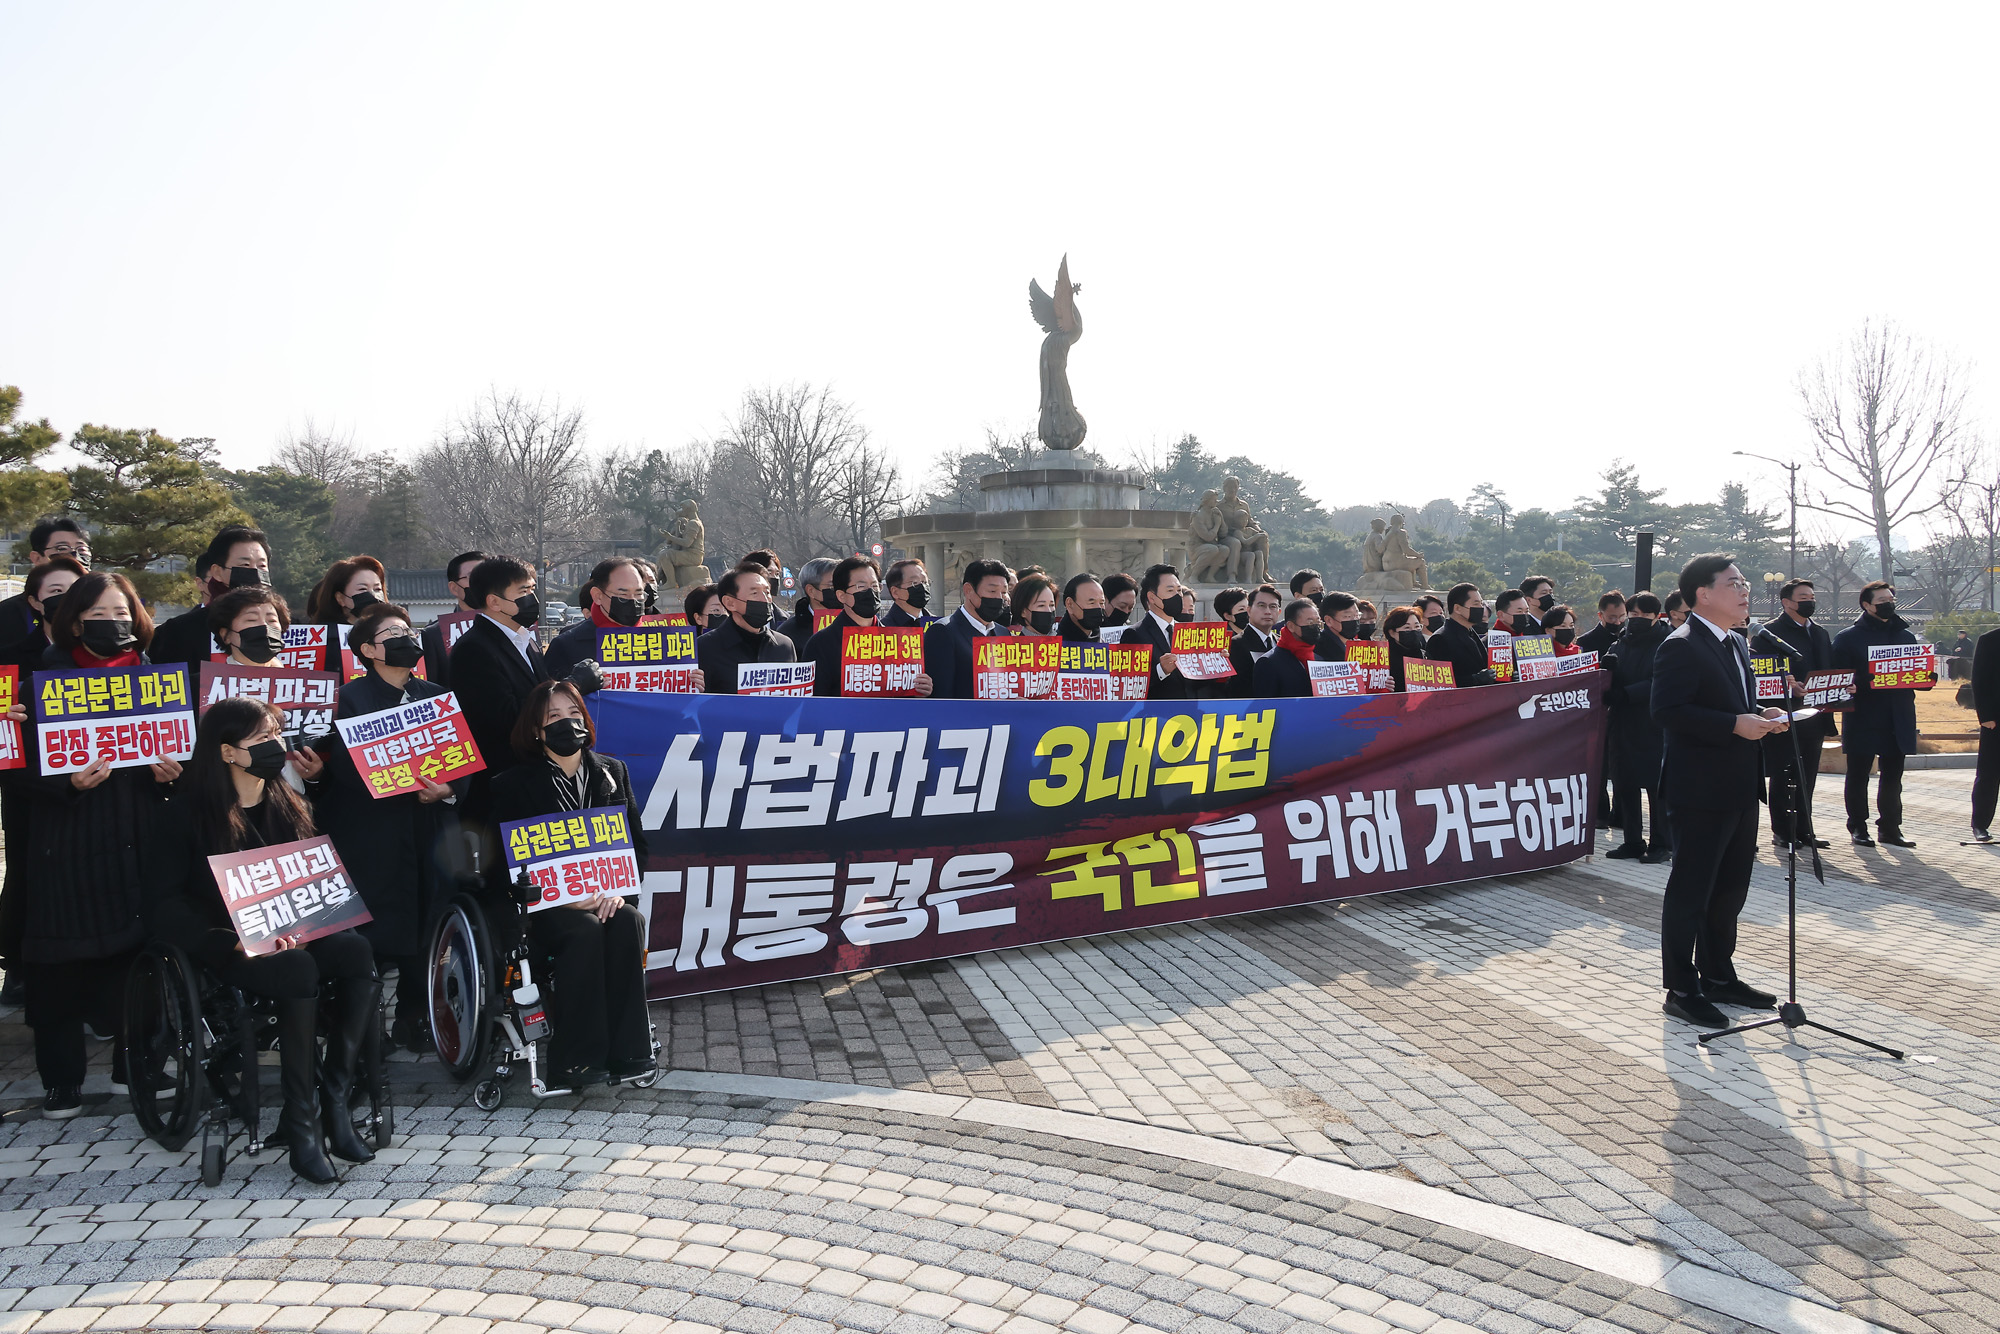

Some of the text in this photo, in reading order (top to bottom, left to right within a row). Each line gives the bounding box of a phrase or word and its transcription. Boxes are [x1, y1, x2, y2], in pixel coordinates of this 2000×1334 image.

[601, 632, 695, 662] 삼권분립 파괴
[845, 633, 922, 659] 사법파괴 3법
[1174, 627, 1208, 650] 사법파괴
[1209, 627, 1225, 649] 3법
[276, 650, 317, 670] 민국
[977, 642, 1060, 668] 사법파괴 3법
[1060, 646, 1107, 670] 분립 파괴
[1109, 650, 1150, 673] 파괴 3법
[1347, 646, 1390, 666] 사법파괴 3법
[1750, 657, 1773, 674] 권분립
[1870, 646, 1920, 660] 사법파괴 악법
[1875, 658, 1927, 674] 대한민국
[741, 665, 811, 687] 사법파괴 악법
[844, 664, 882, 693] 대통령은
[977, 671, 1019, 699] 대통령은
[1316, 678, 1359, 695] 대한민국
[1406, 662, 1453, 684] 사법파괴 3법
[41, 670, 187, 716] 삼권분립 파괴
[207, 677, 338, 705] 사법 파괴
[1061, 677, 1108, 700] 중단하라!
[1540, 689, 1591, 713] 국민의힘
[345, 701, 437, 745] 사법파괴 악법
[45, 719, 191, 769] 당장 중단하라!
[362, 720, 459, 768] 대한민국
[368, 740, 477, 794] 헌정 수호!
[642, 709, 1276, 831] 사법파괴 3대악법
[509, 812, 629, 861] 삼권분립 파괴
[225, 843, 341, 905] 사법 파괴
[562, 856, 636, 896] 중단하라!
[643, 773, 1588, 973] 대통령은 국민을 위해 거부하라!
[236, 873, 352, 939] 독재 완성
